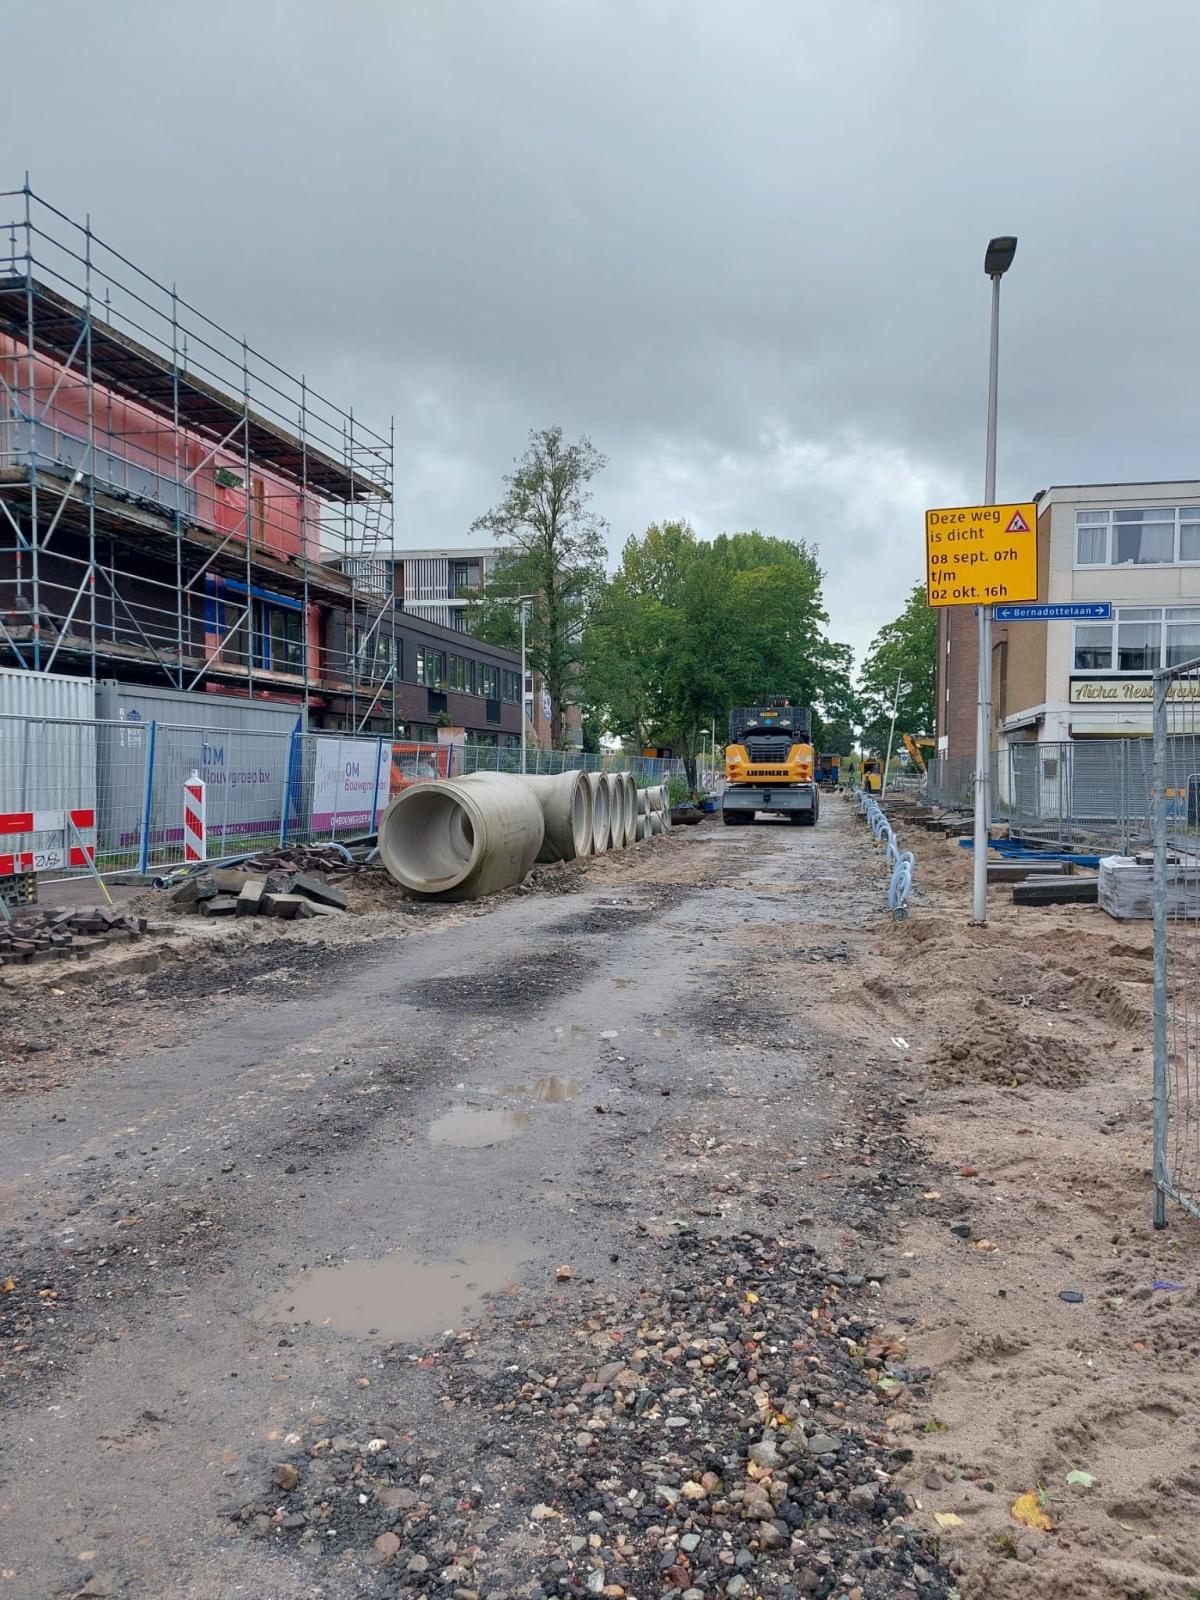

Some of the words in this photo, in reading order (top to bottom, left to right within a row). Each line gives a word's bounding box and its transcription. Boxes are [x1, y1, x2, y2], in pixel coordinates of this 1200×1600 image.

[930, 512, 966, 525] Deze
[971, 510, 1001, 523] weg
[930, 530, 942, 543] is
[947, 527, 985, 542] dicht
[931, 554, 948, 565] 08
[953, 550, 989, 565] sept.
[994, 548, 1018, 561] 07h
[931, 570, 956, 585] t/m
[931, 589, 948, 600] 02
[952, 586, 980, 599] okt.
[984, 584, 1008, 597] 16h
[1013, 608, 1092, 616] Bernadottelaan
[203, 746, 224, 766] OM
[345, 761, 360, 778] OM
